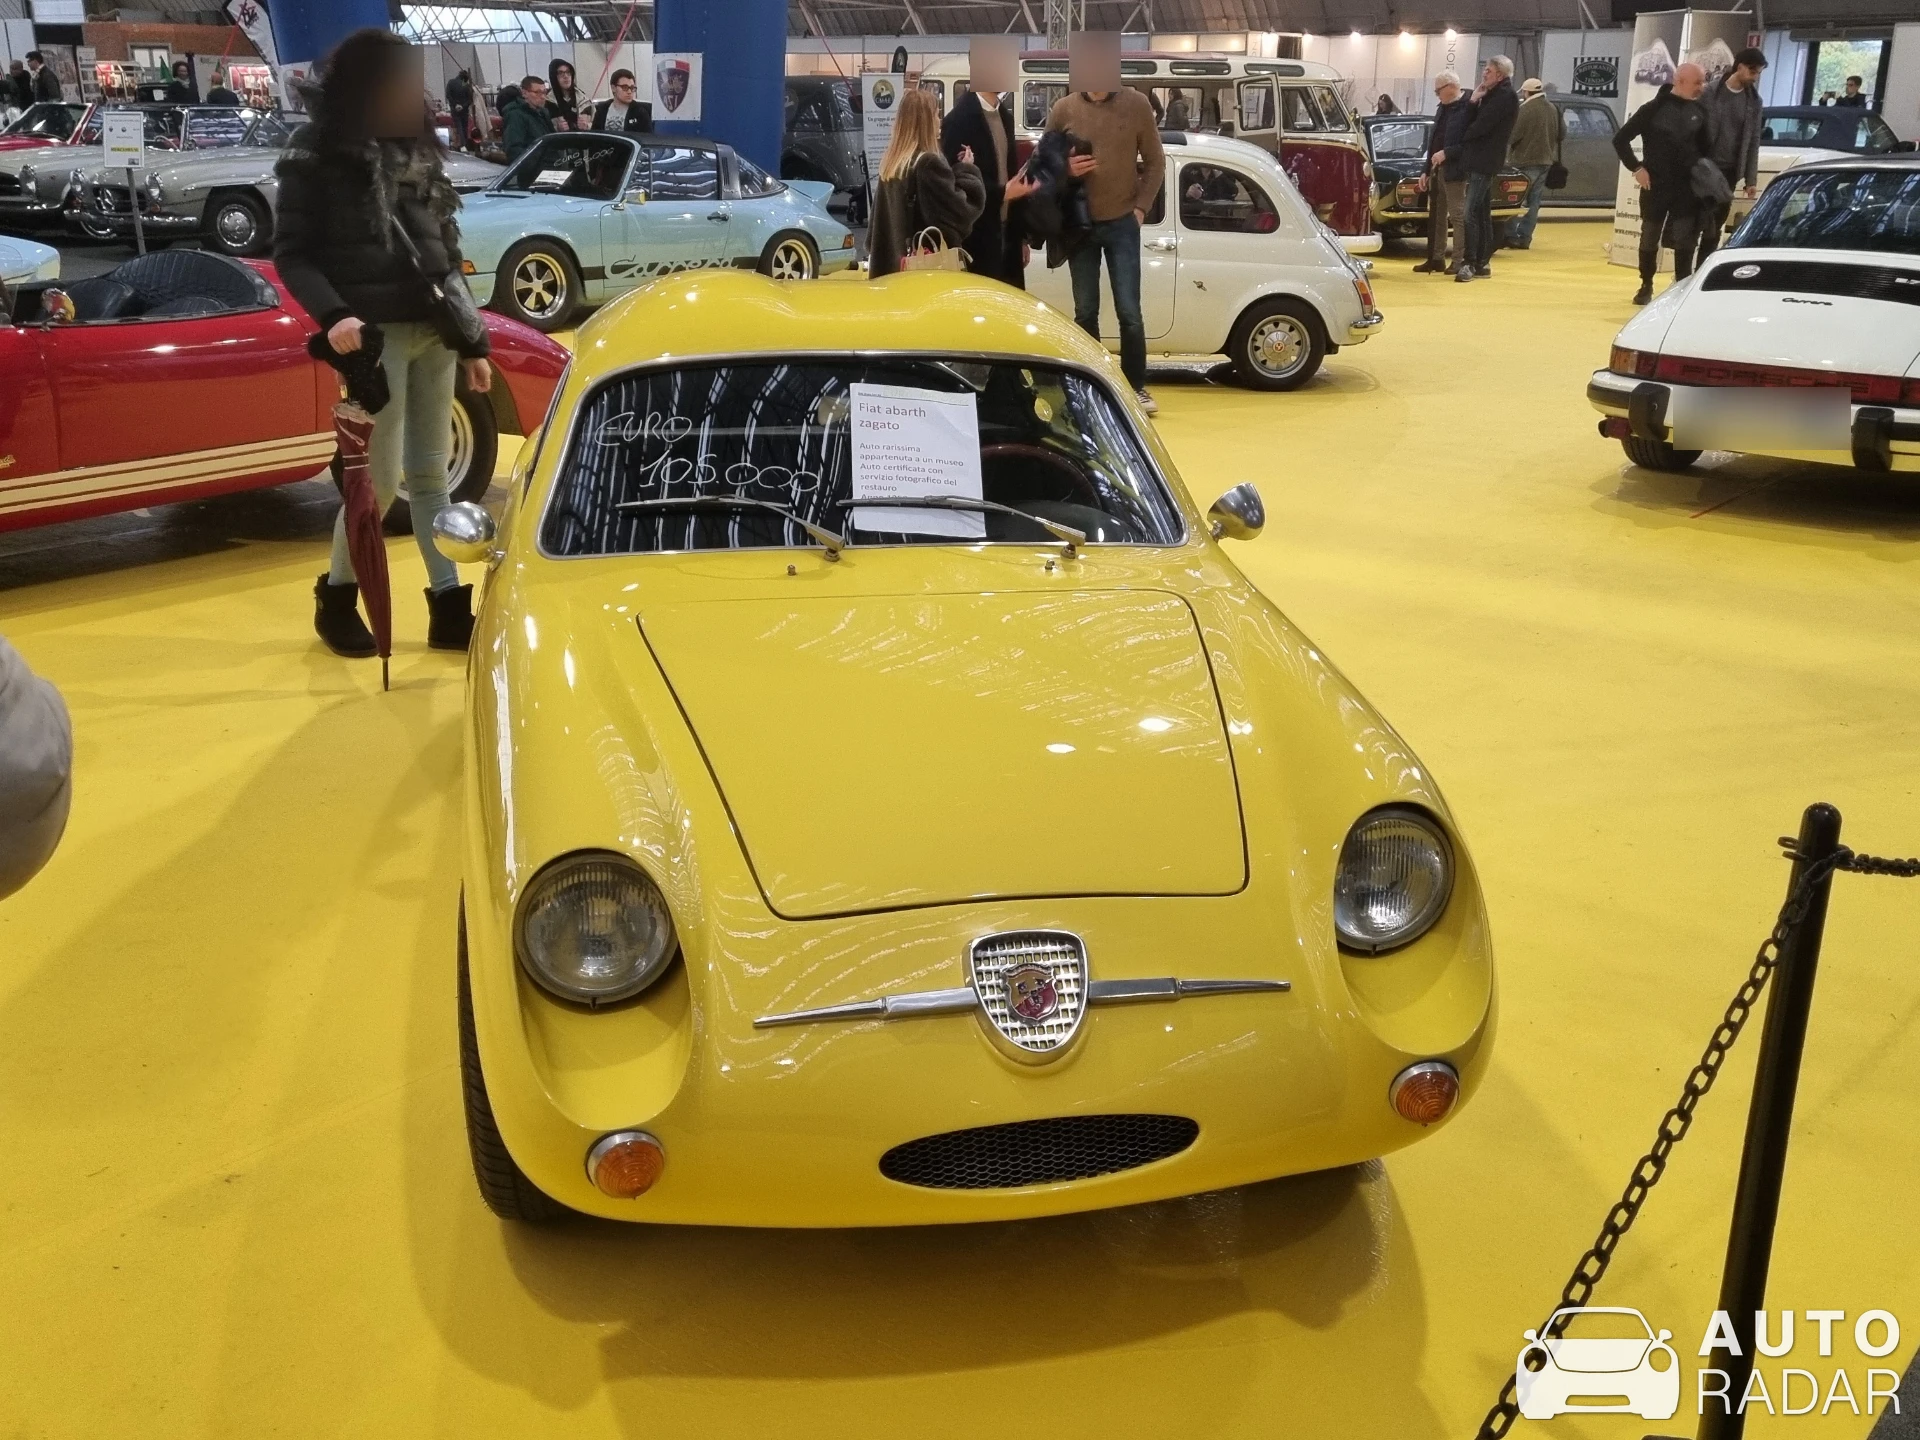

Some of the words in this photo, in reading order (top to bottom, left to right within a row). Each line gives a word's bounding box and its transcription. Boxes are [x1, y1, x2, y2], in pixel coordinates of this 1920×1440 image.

[604, 254, 739, 279] Carrera
[1782, 297, 1833, 306] Carrera
[859, 402, 882, 414] Fiat
[885, 405, 926, 418] abarth
[594, 411, 693, 447] EURO
[859, 419, 900, 431] zagato
[859, 442, 880, 450] Auto
[882, 444, 921, 453] rarissima
[859, 453, 913, 463] appartenuta
[935, 459, 964, 467] museo
[639, 449, 820, 492] 105.000
[883, 464, 926, 473] certificata
[895, 475, 942, 485] fotografico
[860, 484, 897, 492] restauro
